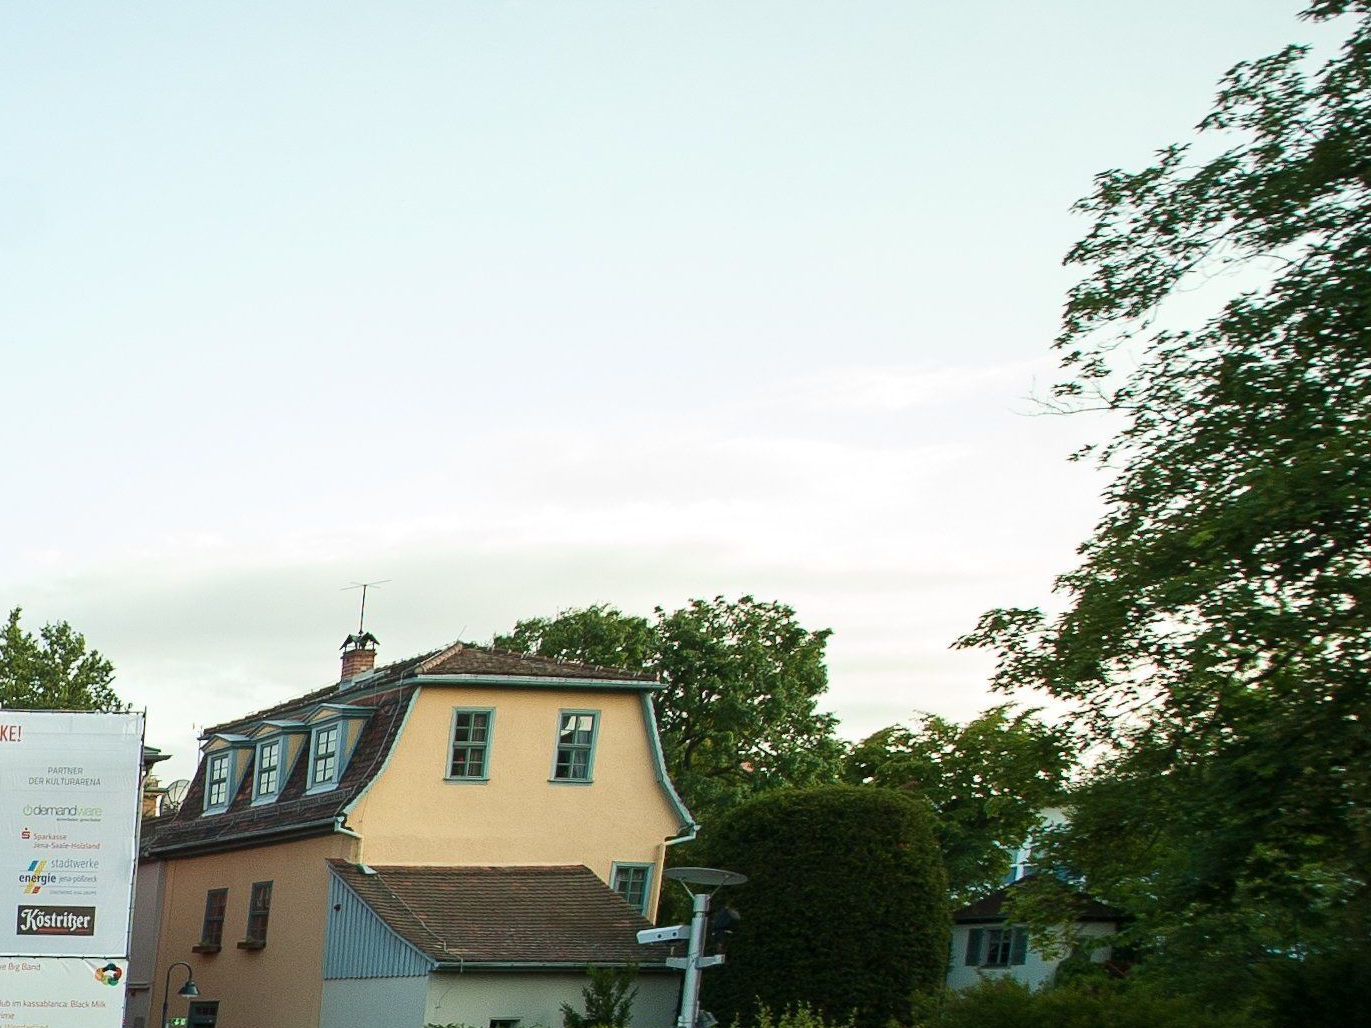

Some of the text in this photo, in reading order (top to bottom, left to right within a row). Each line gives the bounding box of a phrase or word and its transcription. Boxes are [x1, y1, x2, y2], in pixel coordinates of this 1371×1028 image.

[47, 767, 84, 775] PARTNER
[46, 778, 101, 786] KULTURARENA
[33, 832, 68, 841] Sparkasse
[51, 858, 100, 869] stadtwerke
[19, 873, 57, 886] energie
[20, 908, 91, 932] Köstritzer
[22, 962, 41, 971] Band
[12, 1000, 22, 1008] im
